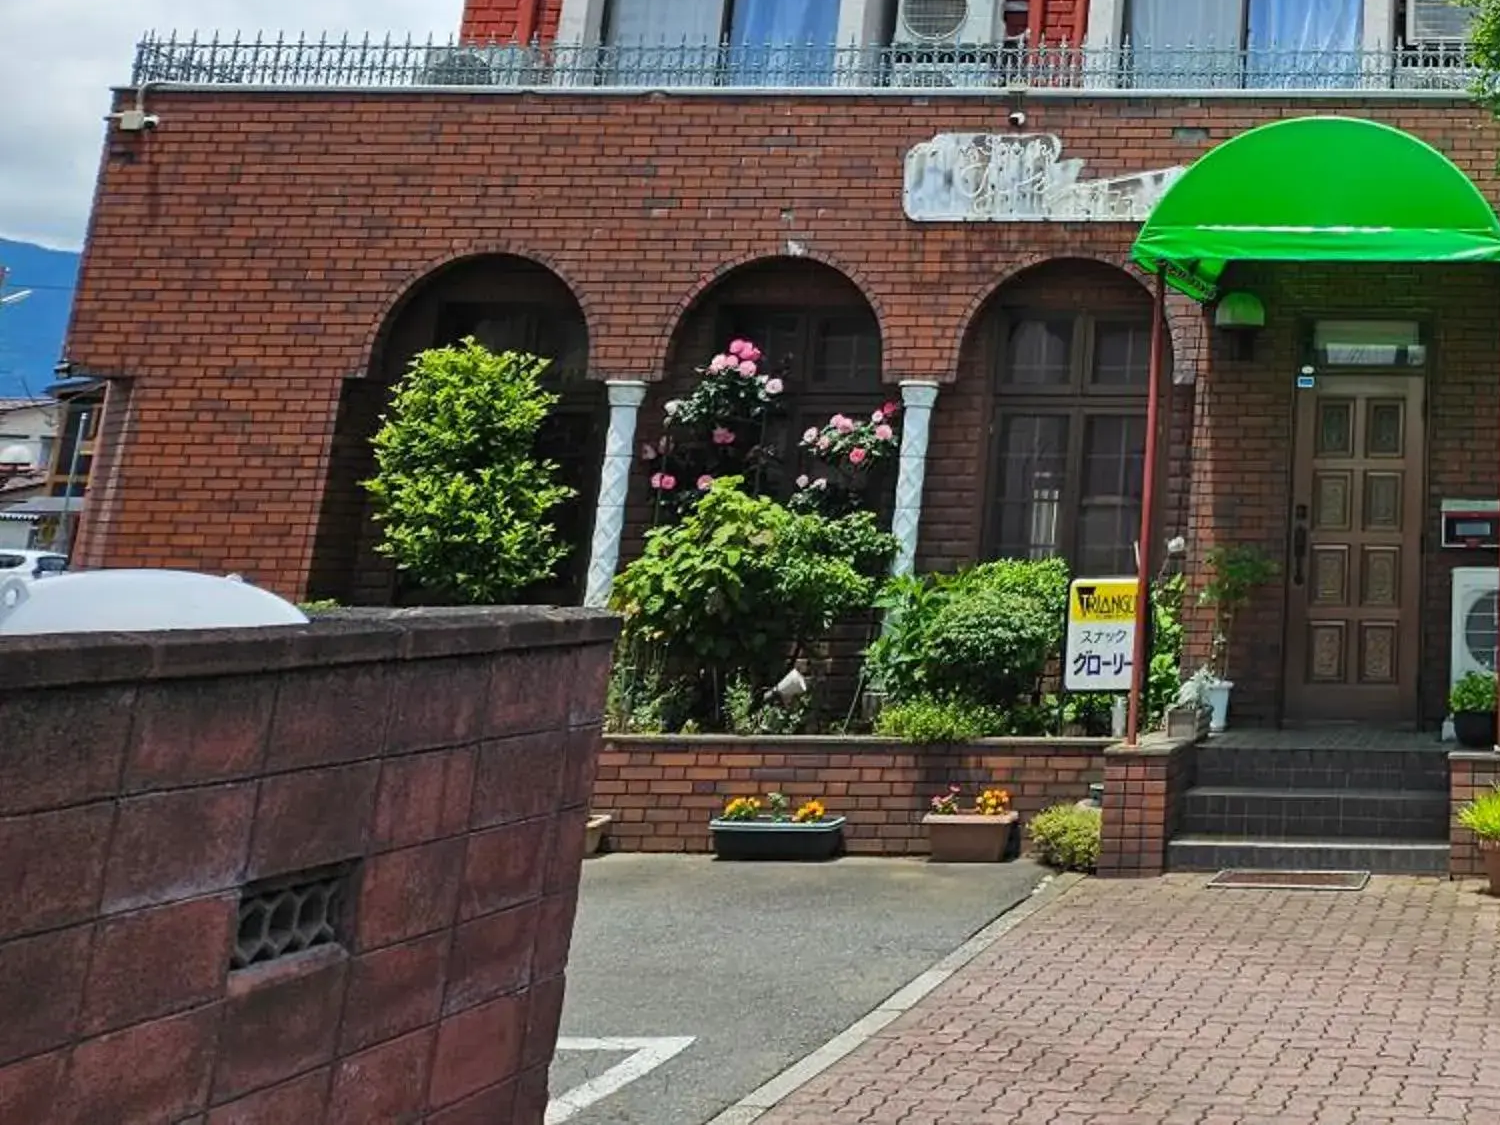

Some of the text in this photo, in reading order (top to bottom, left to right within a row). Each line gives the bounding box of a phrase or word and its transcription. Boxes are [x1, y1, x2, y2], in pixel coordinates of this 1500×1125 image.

[1077, 587, 1136, 616] TRIANGL
[1080, 629, 1127, 645] スナック
[1072, 650, 1134, 676] グローリー
